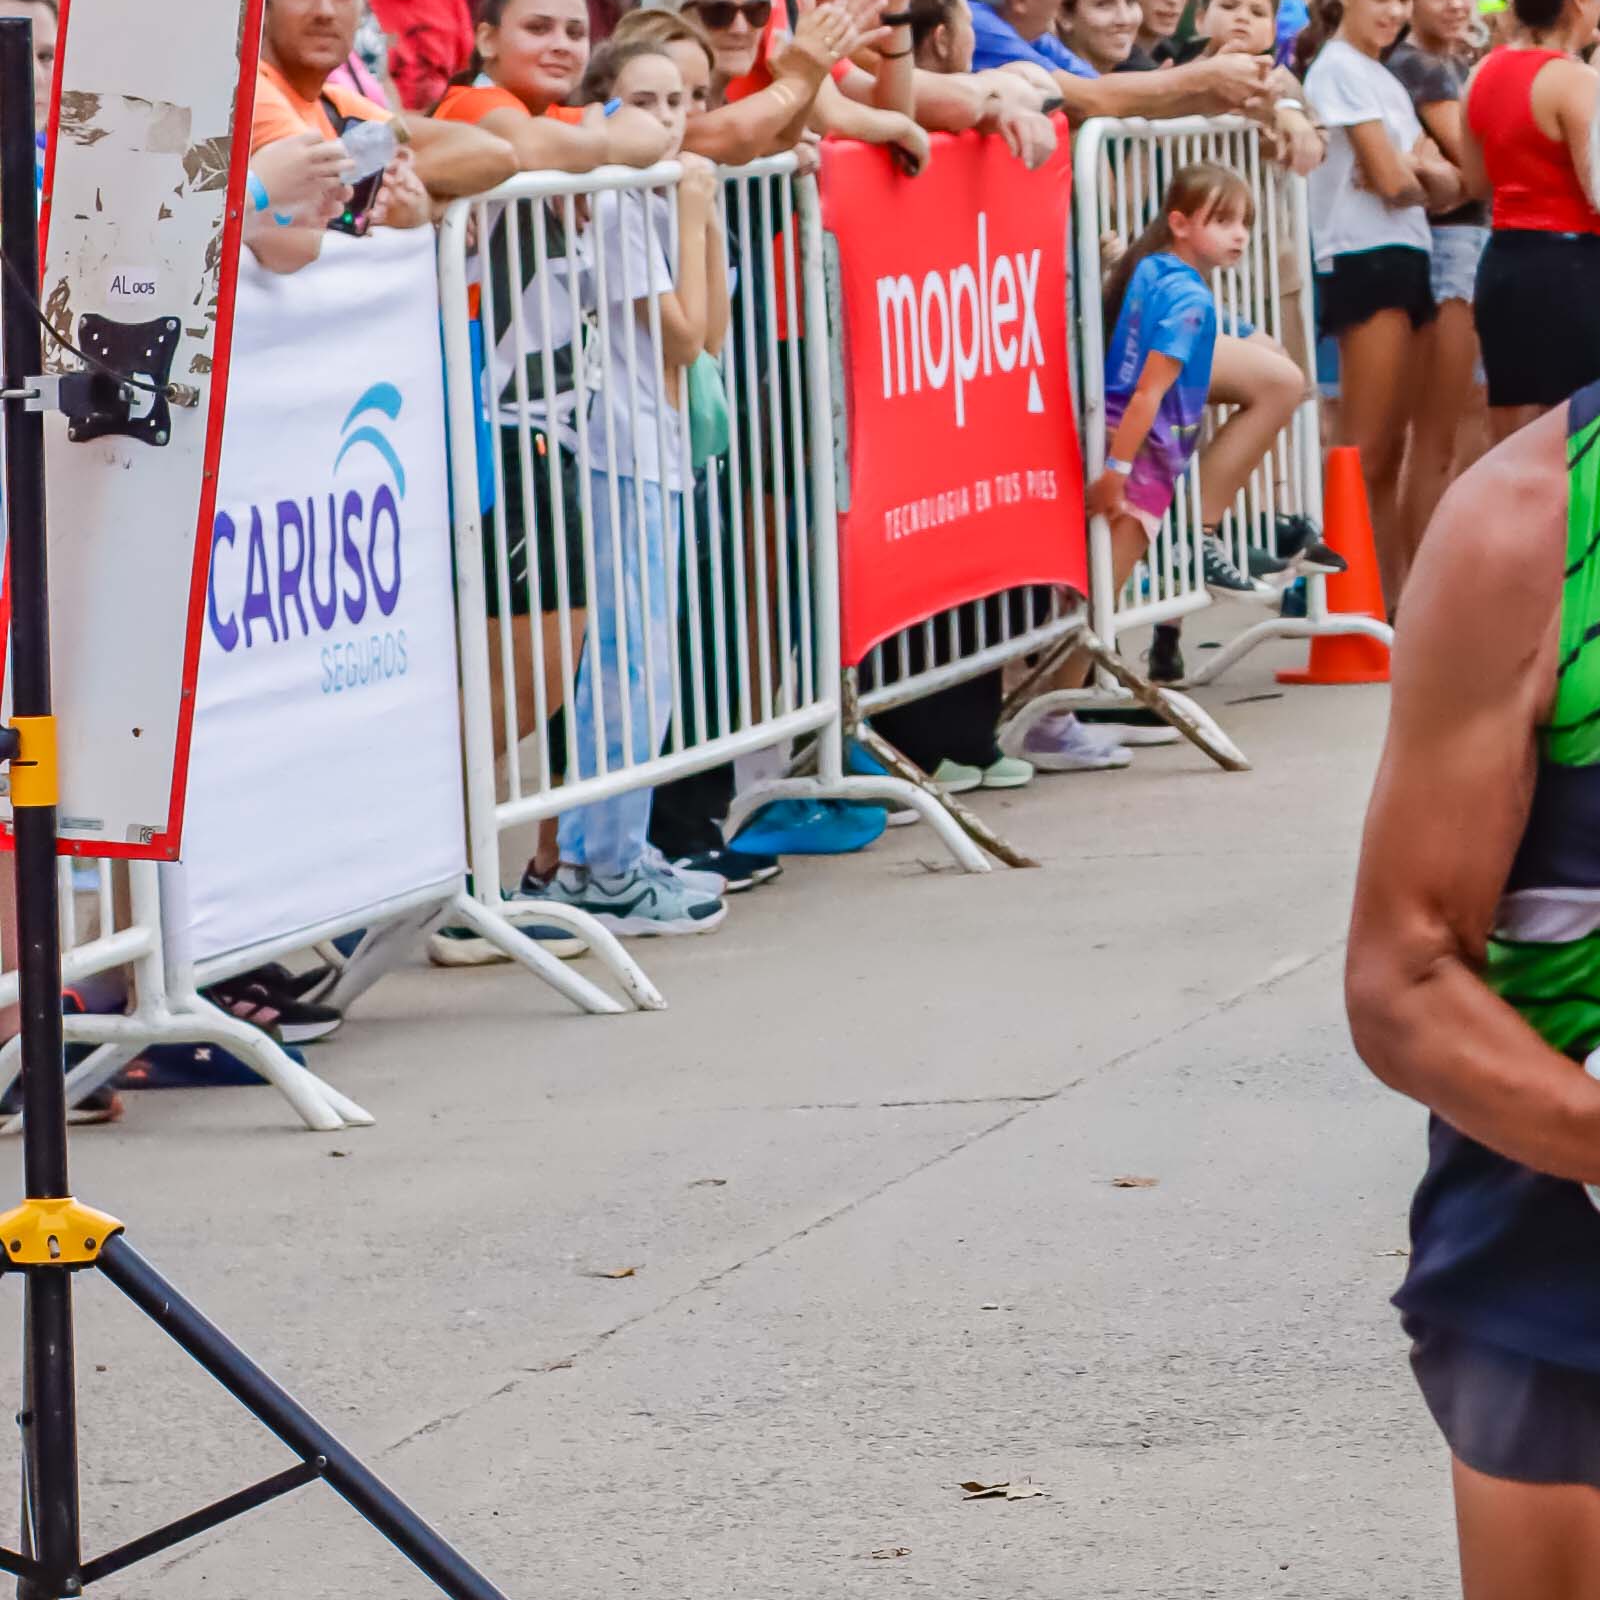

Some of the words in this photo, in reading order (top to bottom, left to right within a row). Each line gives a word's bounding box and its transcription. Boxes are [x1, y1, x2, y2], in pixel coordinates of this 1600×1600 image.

[876, 211, 1046, 428] moplex
[975, 480, 991, 512] EN
[207, 482, 401, 652] CARUSO
[320, 629, 407, 694] SEGUROS
